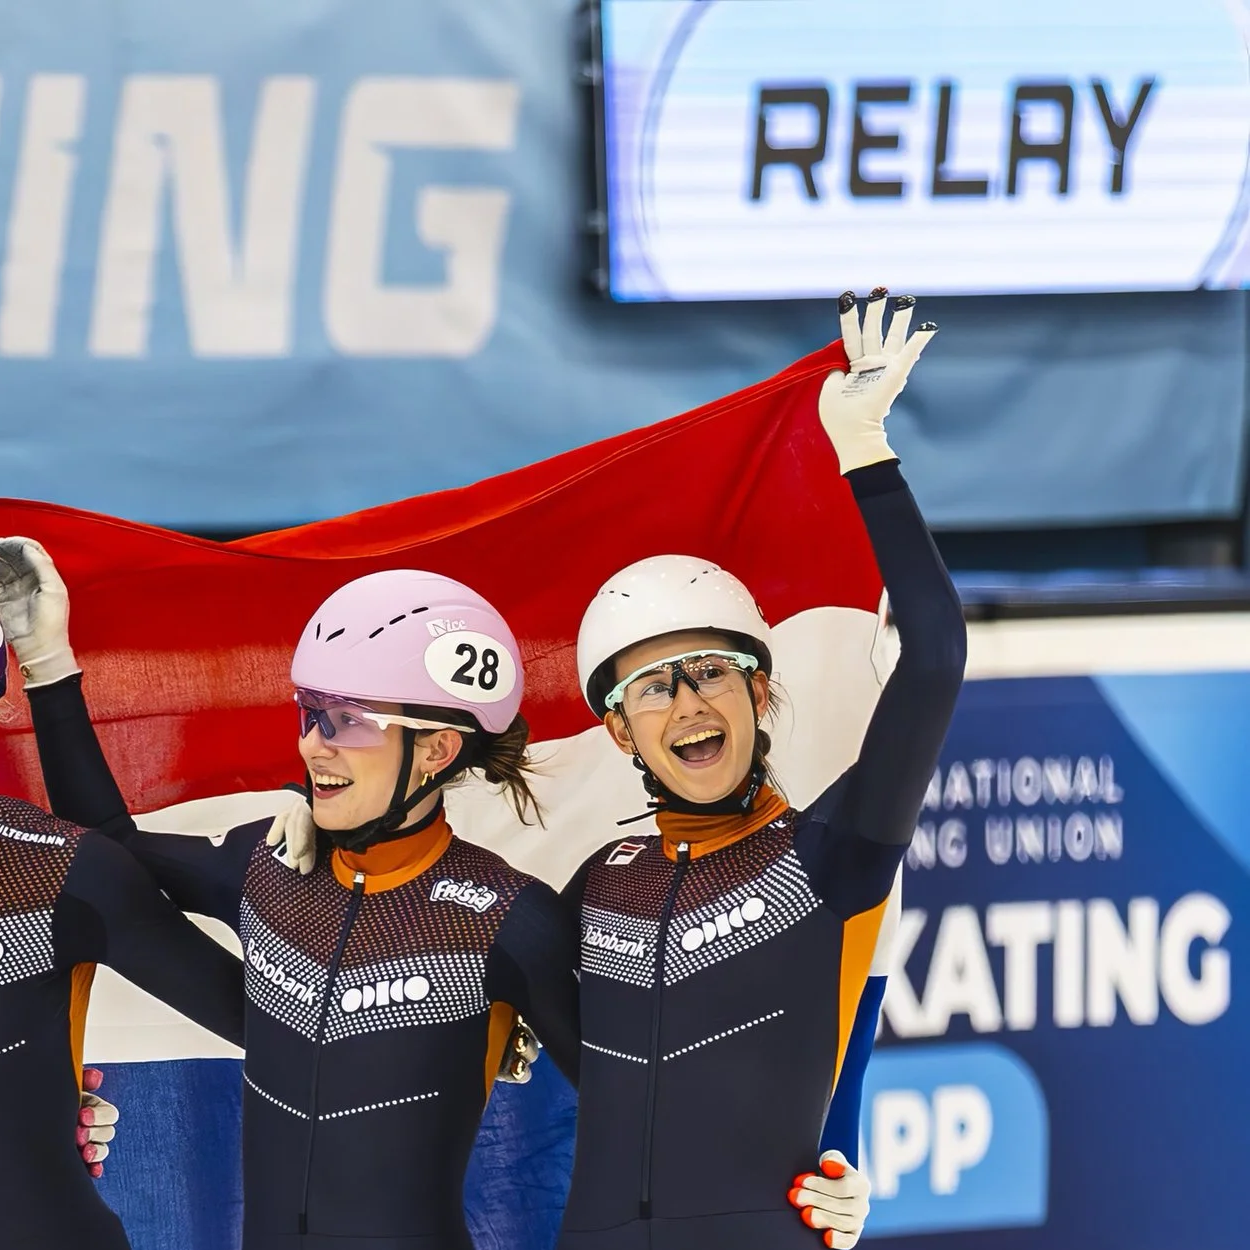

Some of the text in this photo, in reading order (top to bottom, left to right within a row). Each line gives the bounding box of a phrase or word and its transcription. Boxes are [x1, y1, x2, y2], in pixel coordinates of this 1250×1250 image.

[751, 77, 1158, 201] RELAY
[450, 643, 499, 691] 28
[984, 808, 1124, 866] UNION
[247, 937, 318, 1006] Rabobank
[856, 1083, 995, 1199] PP
